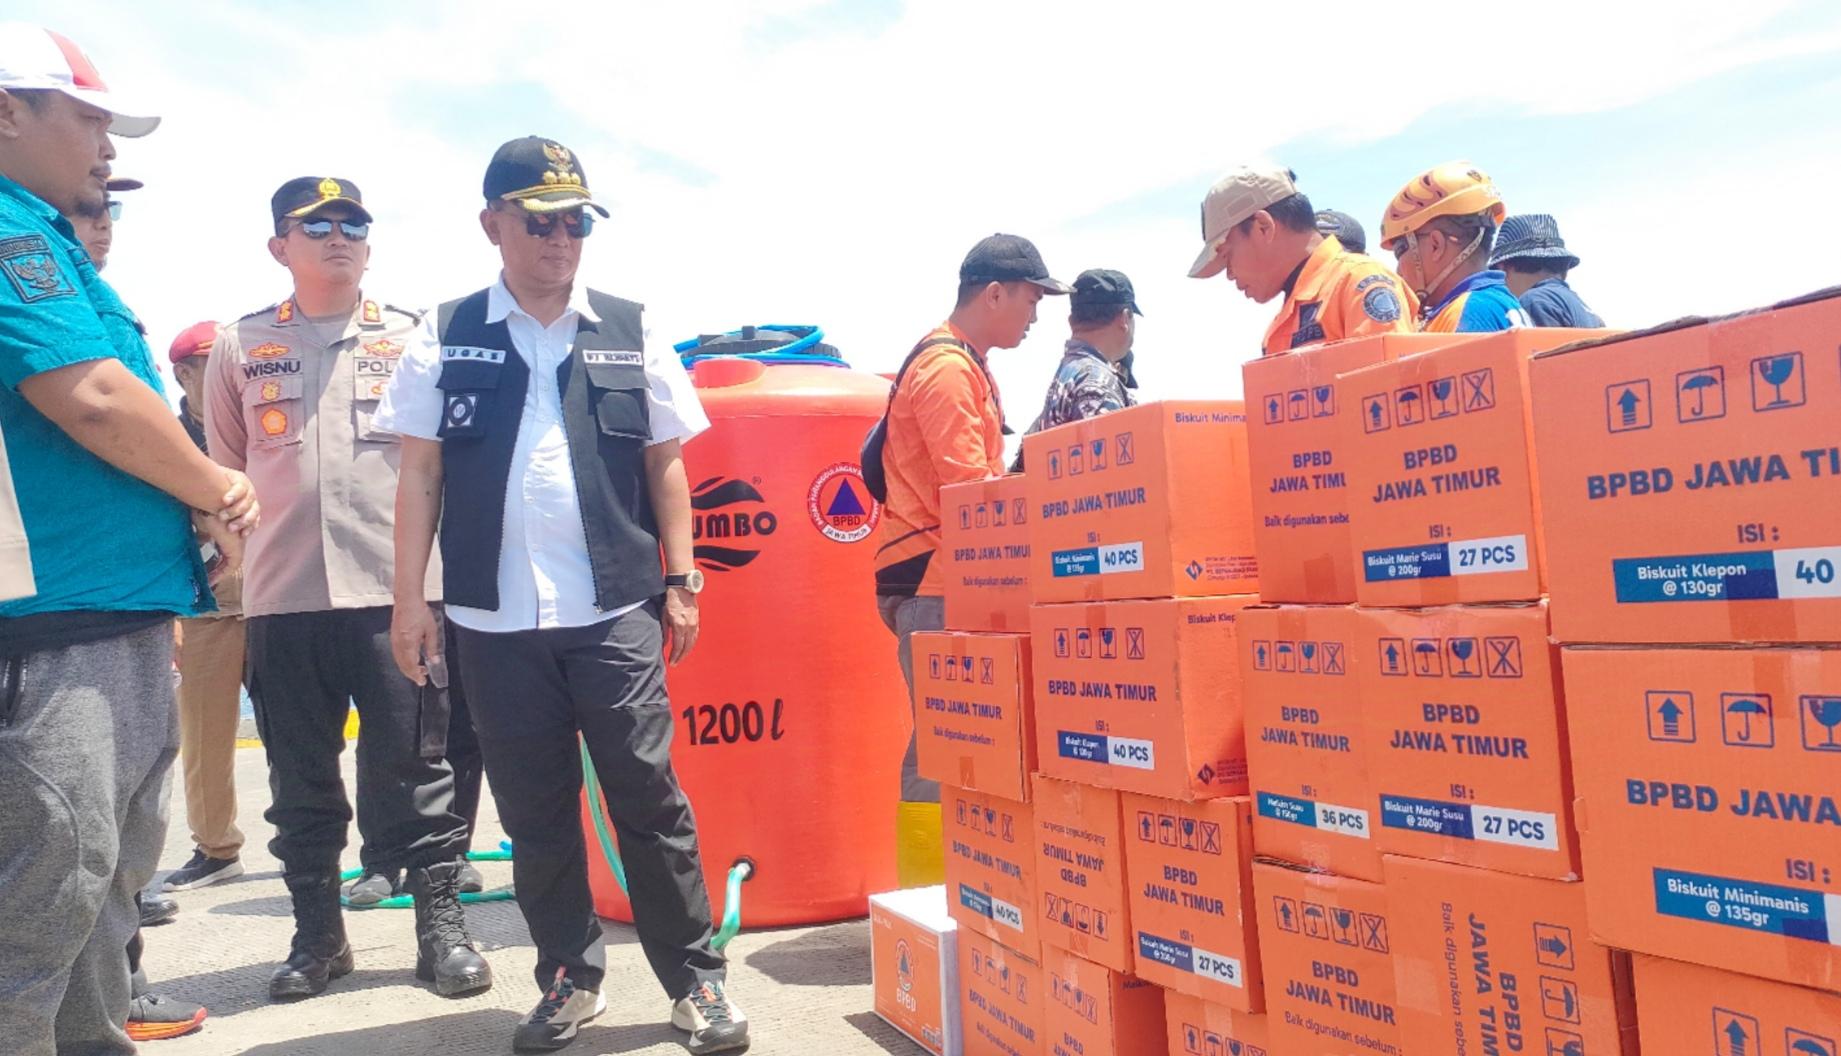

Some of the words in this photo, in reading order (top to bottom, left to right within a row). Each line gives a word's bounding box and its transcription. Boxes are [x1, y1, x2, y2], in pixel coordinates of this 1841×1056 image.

[243, 361, 301, 379] WISNU
[1175, 412, 1208, 423] Biskuit
[1293, 450, 1332, 469] BPBD
[1403, 444, 1458, 470] BPBD
[1270, 476, 1309, 493] JAWA
[1372, 475, 1427, 504] JAWA
[1431, 466, 1502, 496] TIMUR
[1587, 467, 1673, 500] BPBD
[1684, 454, 1790, 490] JAWA
[1042, 500, 1070, 519] BPBD
[1071, 496, 1104, 515] JAWA
[1106, 487, 1146, 508] TIMUR
[833, 516, 860, 526] BPBD
[1429, 525, 1443, 538] ISI
[1737, 523, 1764, 544] ISI
[954, 548, 976, 561] BPBD
[978, 546, 1002, 560] JAWA
[1104, 551, 1116, 566] 40
[1118, 549, 1138, 565] PCS
[1367, 555, 1395, 567] Biskuit
[1396, 553, 1419, 564] Marie
[1421, 551, 1442, 562] Susu
[1458, 548, 1477, 567] 27
[1482, 545, 1515, 565] PCS
[1398, 565, 1422, 577] 200gr
[1637, 565, 1687, 580] Biskuit
[1692, 563, 1747, 581] Klepon
[1795, 558, 1834, 584] 40
[1662, 581, 1677, 595] @
[1680, 580, 1724, 597] 130gr
[1048, 679, 1076, 696] BPBD
[1079, 682, 1112, 699] JAWA
[1115, 683, 1157, 702] TIMUR
[925, 696, 945, 712] BPBD
[947, 700, 970, 716] JAWA
[972, 703, 1002, 720] TIMUR
[1281, 706, 1319, 724] BPBD
[1422, 703, 1480, 725] BPBD
[682, 700, 764, 746] 1200
[1261, 727, 1298, 747] JAWA
[1301, 731, 1351, 752] TIMUR
[1390, 730, 1447, 753] JAWA
[1451, 734, 1529, 760] TIMUR
[1114, 744, 1126, 759] 40
[1129, 746, 1149, 761] PCS
[1384, 801, 1413, 814] Biskuit
[1415, 805, 1441, 818] Marie
[1442, 809, 1465, 821] Susu
[1626, 778, 1719, 812] BPBD
[1730, 789, 1841, 826] JAWA
[1322, 809, 1336, 825] 36
[1339, 812, 1363, 830] PCS
[1417, 816, 1443, 832] 200gr
[1483, 815, 1502, 834] 27
[1508, 818, 1545, 841] PCS
[1043, 842, 1074, 863] TIMUR
[1076, 852, 1104, 872] JAWA
[1060, 868, 1087, 887] BPBD
[1164, 865, 1197, 886] BPBD
[1785, 858, 1815, 882] ISI
[1144, 883, 1178, 904] JAWA
[1181, 892, 1224, 916] TIMUR
[1667, 878, 1720, 900] Biskuit
[1724, 886, 1809, 914] Minimanis
[1441, 902, 1455, 933] Baik
[1705, 900, 1720, 918] @
[1725, 903, 1769, 927] 135gr
[1468, 912, 1492, 995] JAWA
[1199, 956, 1210, 971] 27
[1213, 960, 1234, 979] PCS
[1312, 960, 1359, 987] BPBD
[1445, 937, 1463, 1016] digunakan
[1286, 979, 1334, 1008] JAWA
[1336, 991, 1396, 1026] TIMUR
[1499, 972, 1523, 1052] BPBD
[1285, 1010, 1304, 1027] Baik
[1305, 1018, 1353, 1042] digunakan
[1354, 1034, 1397, 1055] sebelum
